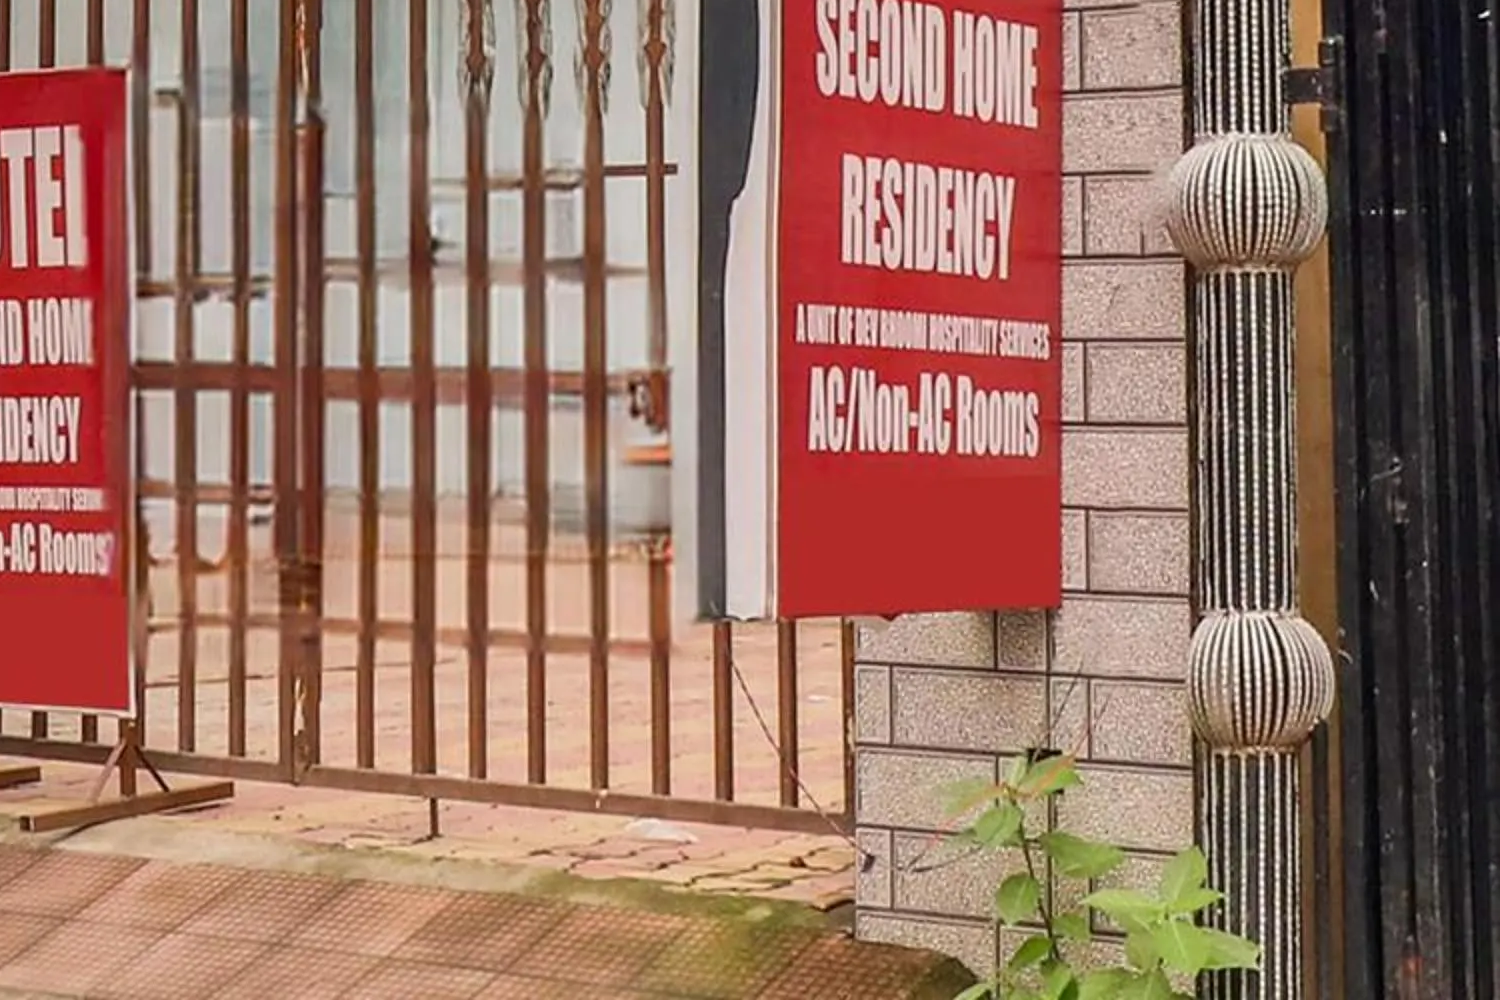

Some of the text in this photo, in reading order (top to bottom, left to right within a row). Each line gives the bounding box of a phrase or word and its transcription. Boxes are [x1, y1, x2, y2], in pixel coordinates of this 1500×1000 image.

[953, 9, 1038, 129] HOME
[841, 153, 1015, 280] RESIDENCY
[838, 306, 854, 346] OF
[808, 364, 1040, 458] AC/Non-AC Rooms
[38, 523, 115, 577] Rooms
